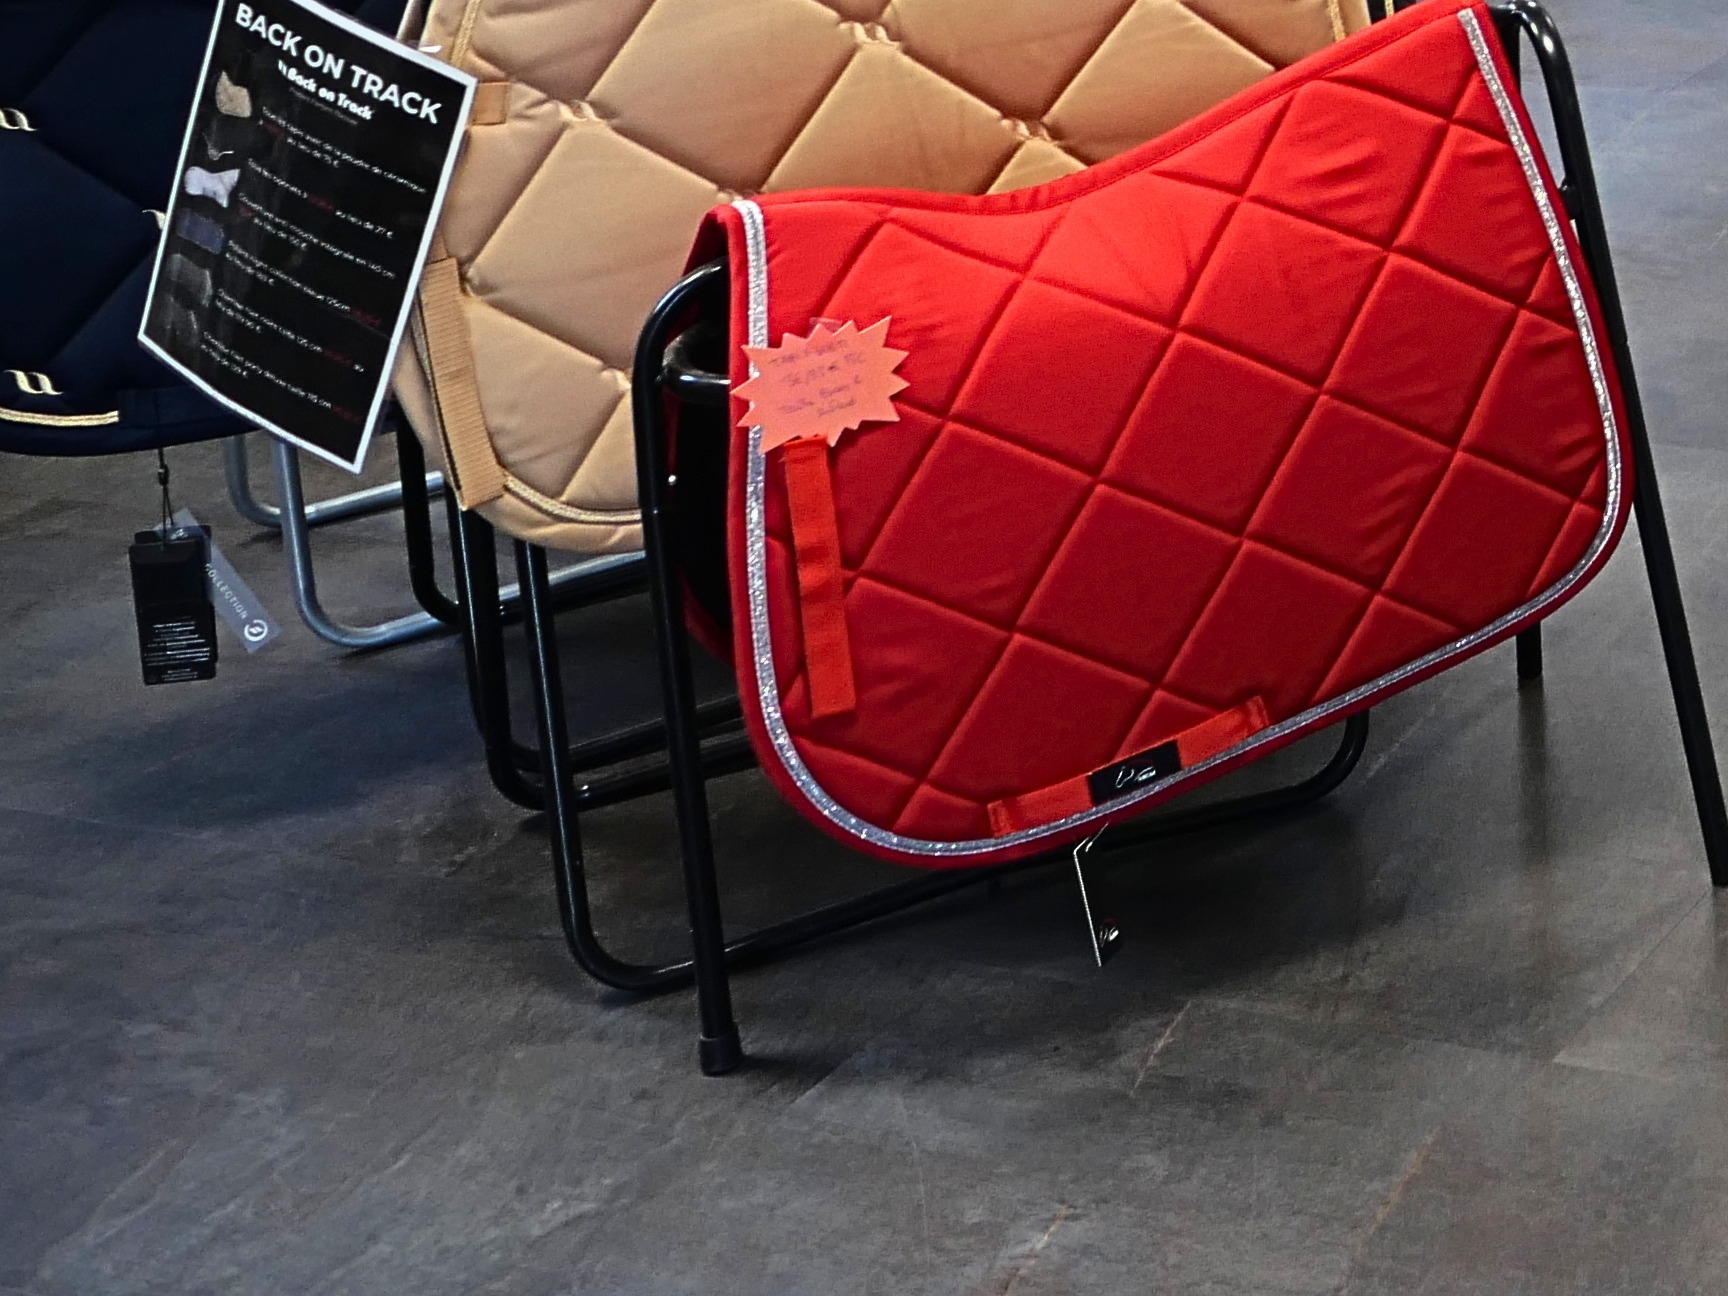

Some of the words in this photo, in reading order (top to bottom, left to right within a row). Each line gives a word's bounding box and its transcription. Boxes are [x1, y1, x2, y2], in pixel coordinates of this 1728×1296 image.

[235, 2, 303, 59] BACK
[303, 44, 346, 81] ON
[349, 63, 443, 125] TRACK
